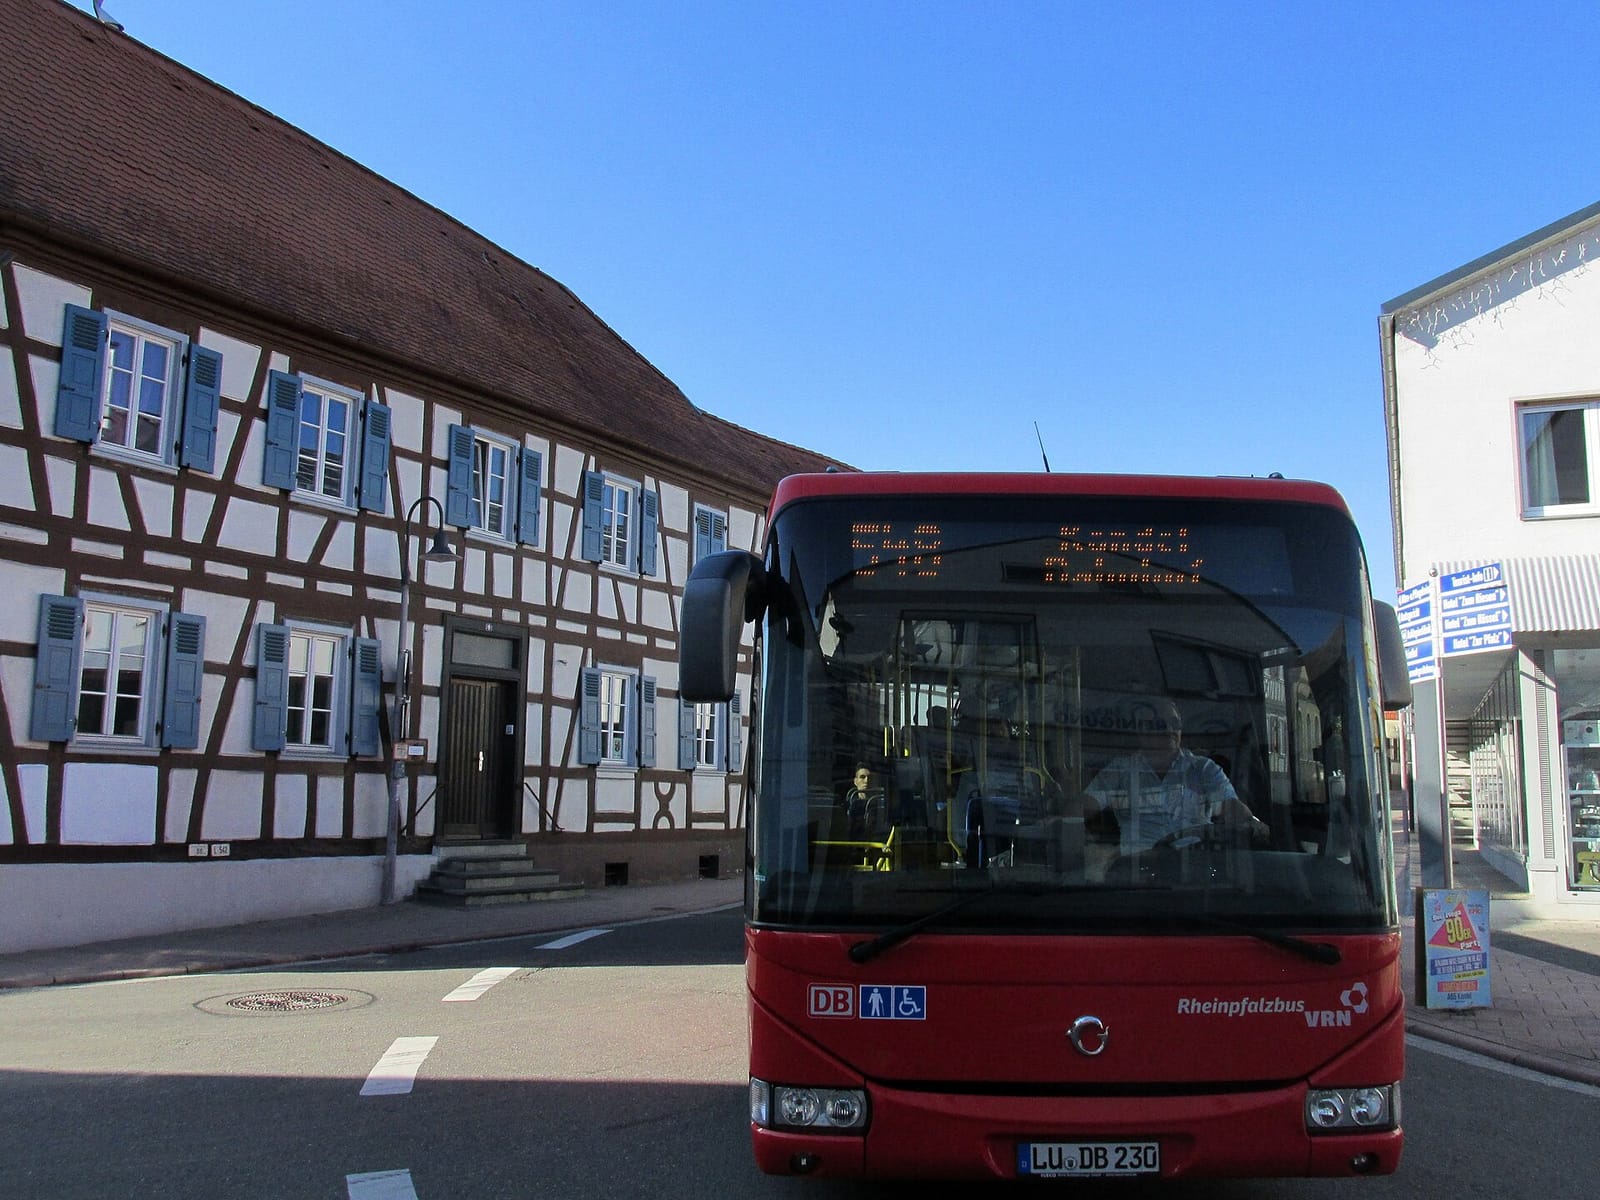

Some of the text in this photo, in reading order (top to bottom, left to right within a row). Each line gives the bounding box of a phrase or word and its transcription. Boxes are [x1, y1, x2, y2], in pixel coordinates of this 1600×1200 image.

[851, 525, 942, 577] 548
[1060, 526, 1188, 553] Kandel
[814, 989, 850, 1013] DB
[1177, 997, 1305, 1017] Rheinpfalzbus
[1305, 1010, 1351, 1027] VRN
[1032, 1147, 1063, 1169] LU
[1079, 1147, 1109, 1169] DB
[1115, 1146, 1157, 1169] 230
